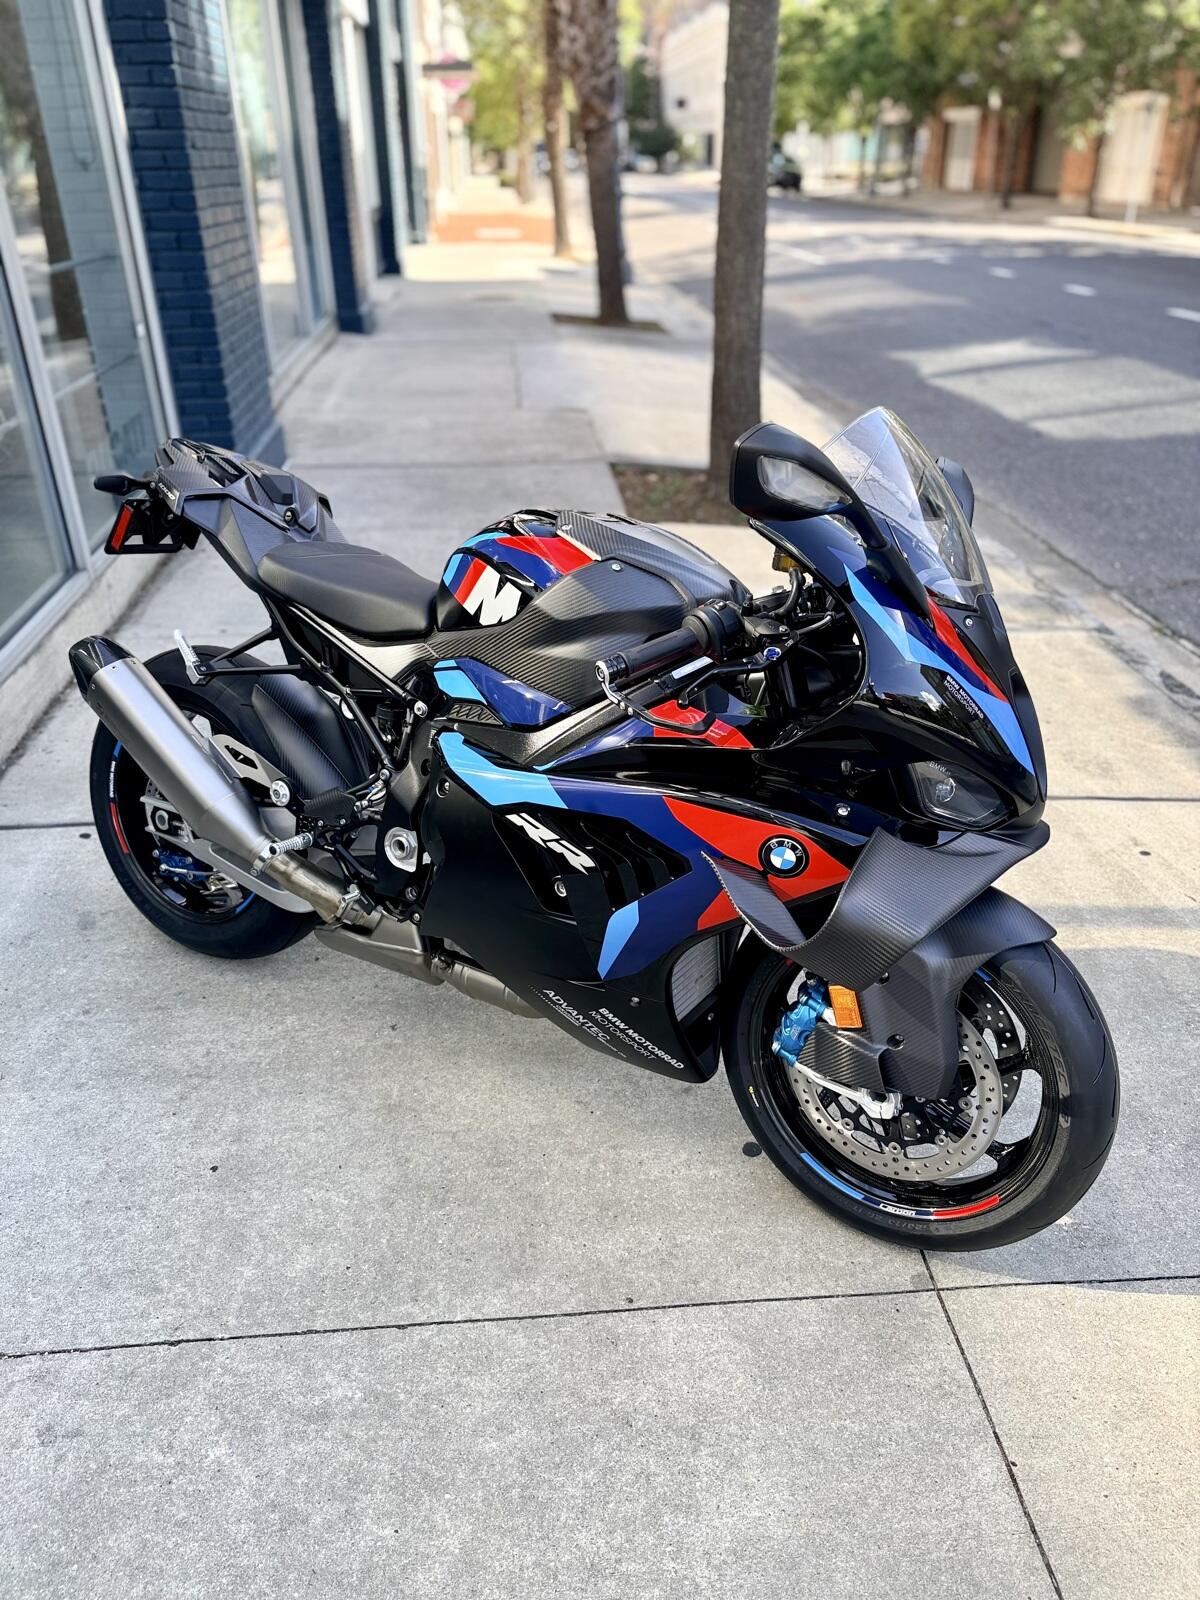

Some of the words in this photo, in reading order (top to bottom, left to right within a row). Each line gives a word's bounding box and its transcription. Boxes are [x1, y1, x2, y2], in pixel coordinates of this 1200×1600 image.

[158, 482, 176, 500] 1000
[462, 565, 522, 626] M
[943, 680, 975, 716] MOTORSPORT
[946, 675, 960, 690] BMW
[960, 689, 984, 719] MOTORRAD
[929, 760, 947, 773] BMW
[505, 813, 596, 875] RR
[769, 840, 803, 857] BMW
[542, 989, 610, 1041] ADVANTEC
[588, 1010, 657, 1060] MOTORSPORT
[598, 1007, 629, 1030] BMW
[624, 1029, 685, 1069] MOTORRAD
